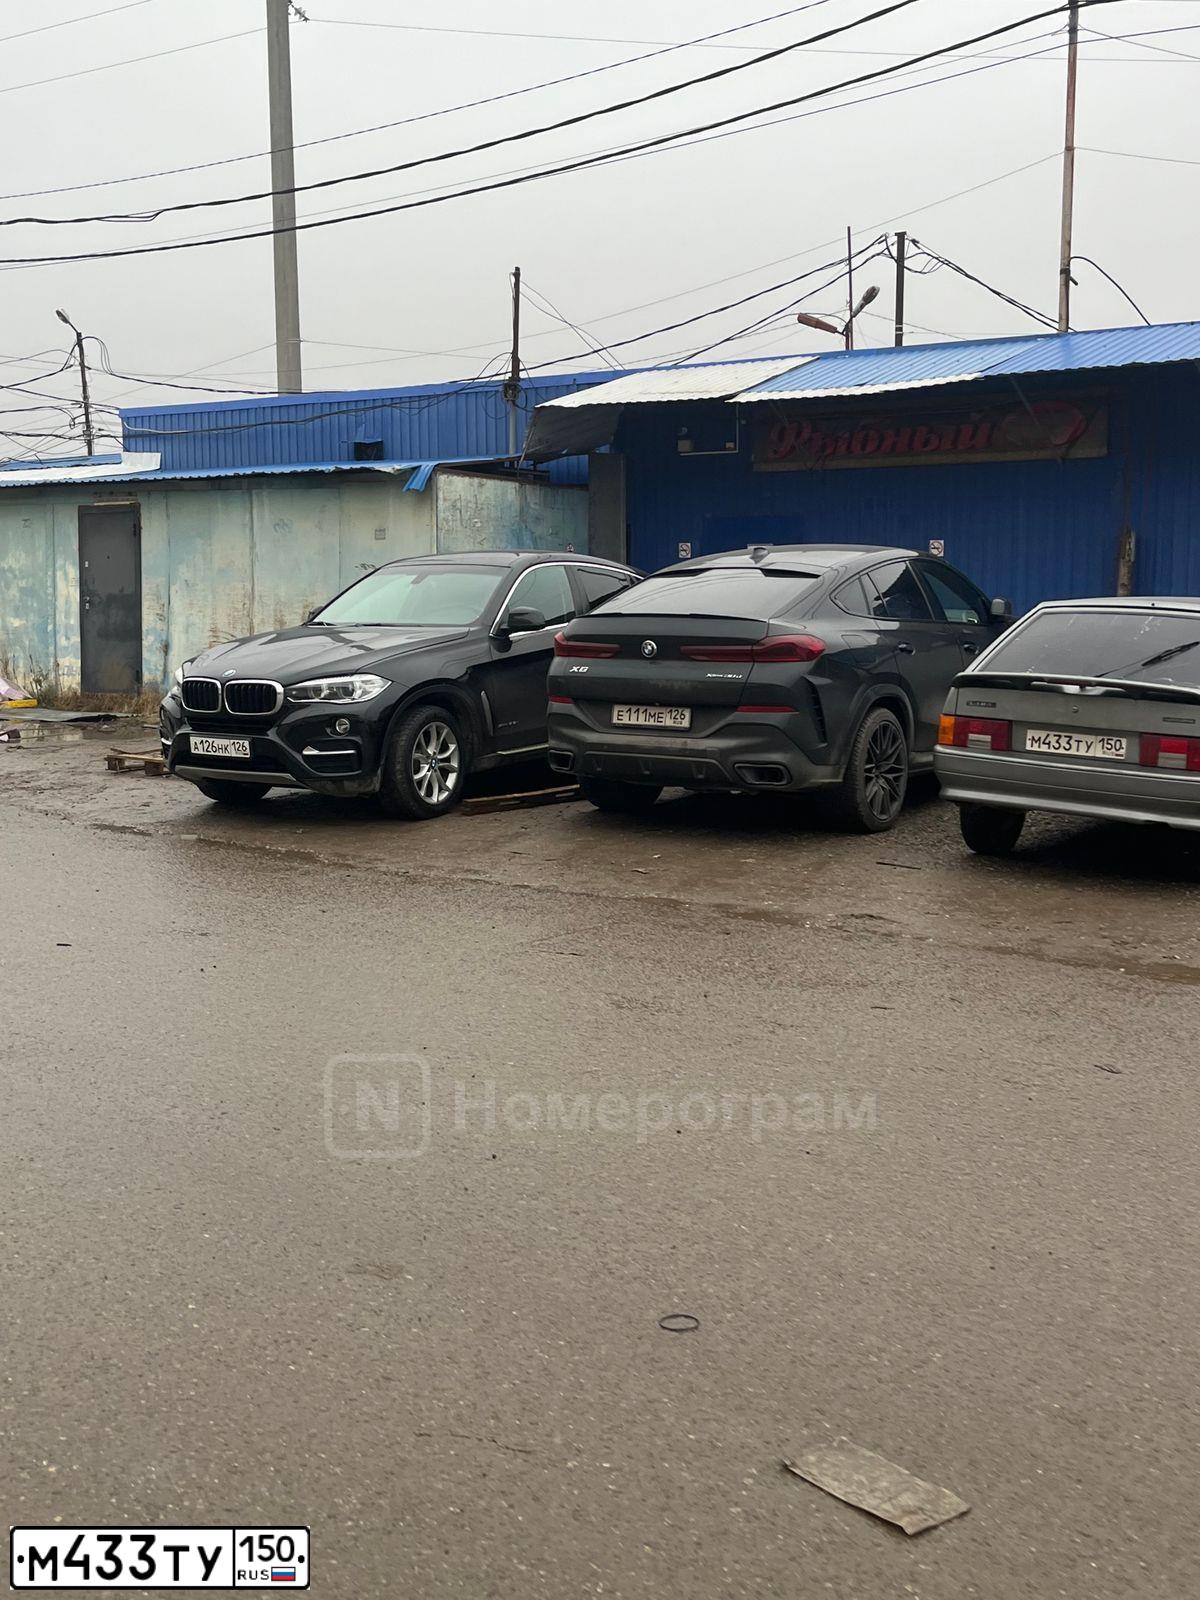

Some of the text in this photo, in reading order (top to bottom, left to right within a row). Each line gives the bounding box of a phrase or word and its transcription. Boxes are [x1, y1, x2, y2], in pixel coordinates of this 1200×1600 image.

[616, 707, 686, 723] Е111МЕ 126
[193, 739, 248, 754] А126НК 126
[1030, 733, 1122, 753] М433ТУ 150
